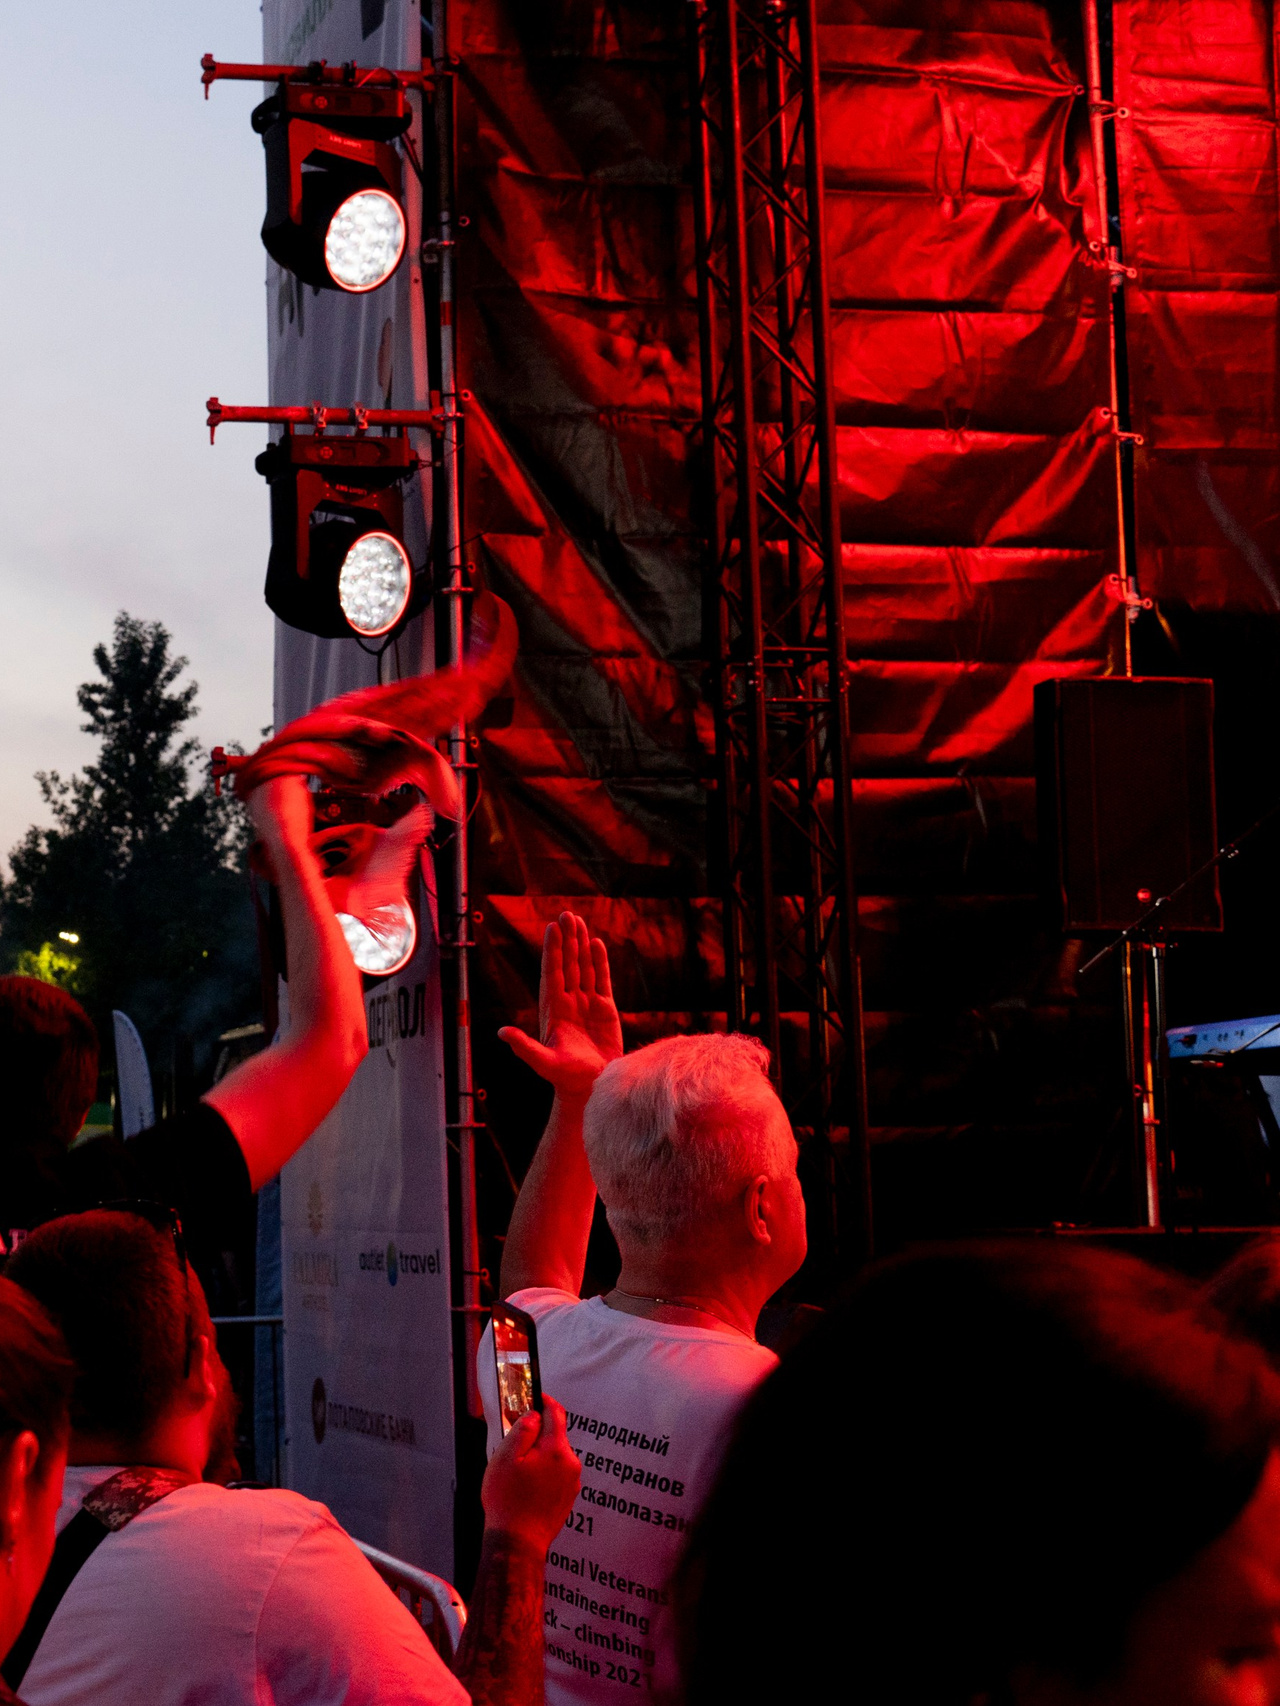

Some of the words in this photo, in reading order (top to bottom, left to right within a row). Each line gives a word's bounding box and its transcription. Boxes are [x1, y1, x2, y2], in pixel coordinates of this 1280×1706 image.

[400, 1249, 440, 1274] travel
[566, 1411, 670, 1456] ународный
[584, 1451, 685, 1498] ветеранов
[589, 1560, 669, 1606] Veterans
[574, 1623, 656, 1668] climbing
